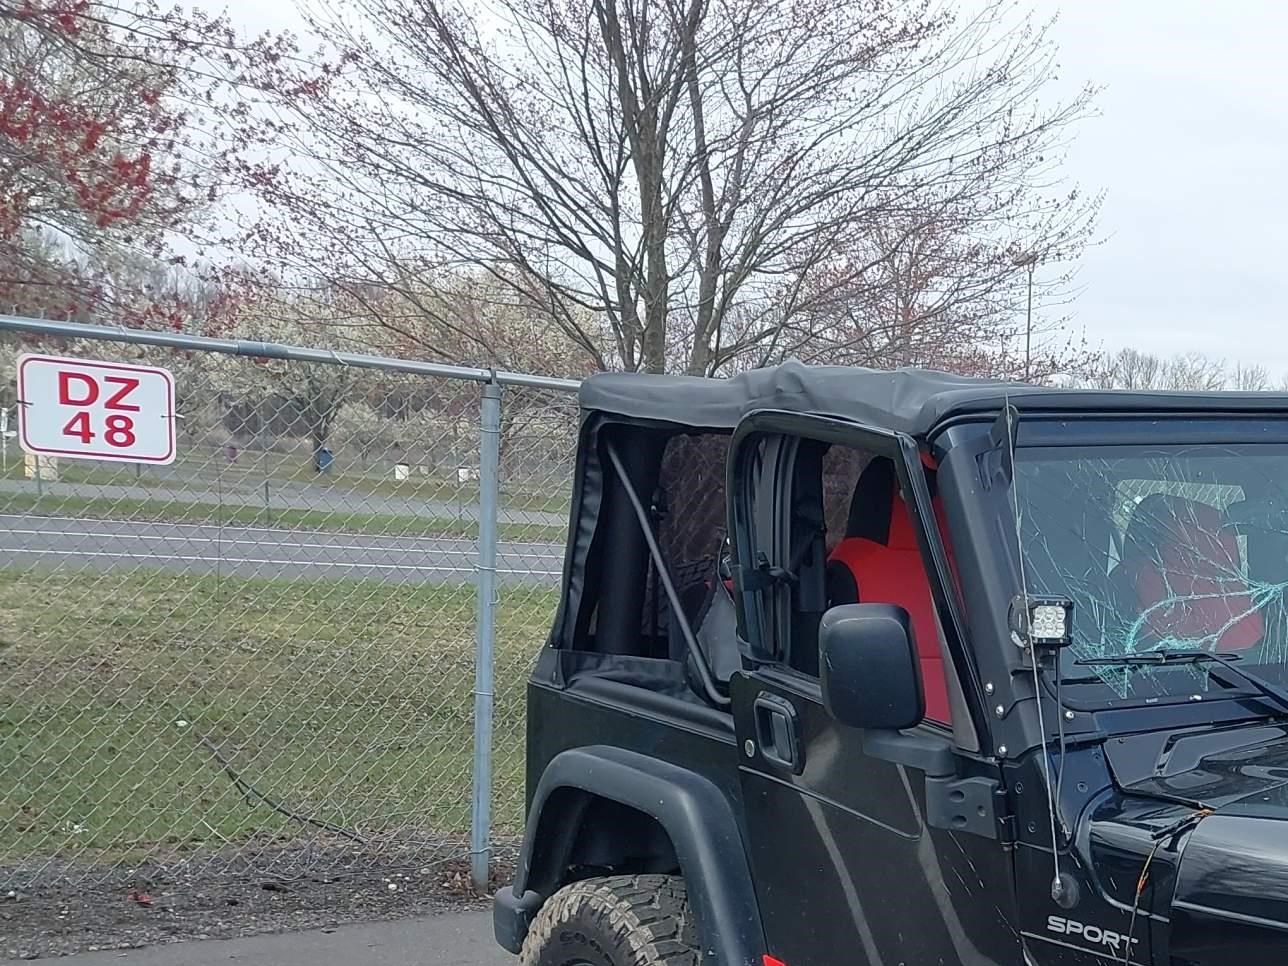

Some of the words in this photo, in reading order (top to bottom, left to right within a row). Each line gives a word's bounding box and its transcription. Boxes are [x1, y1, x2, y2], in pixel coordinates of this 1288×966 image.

[58, 371, 140, 412] DZ
[62, 411, 136, 447] 48
[1047, 915, 1139, 949] SPORT
